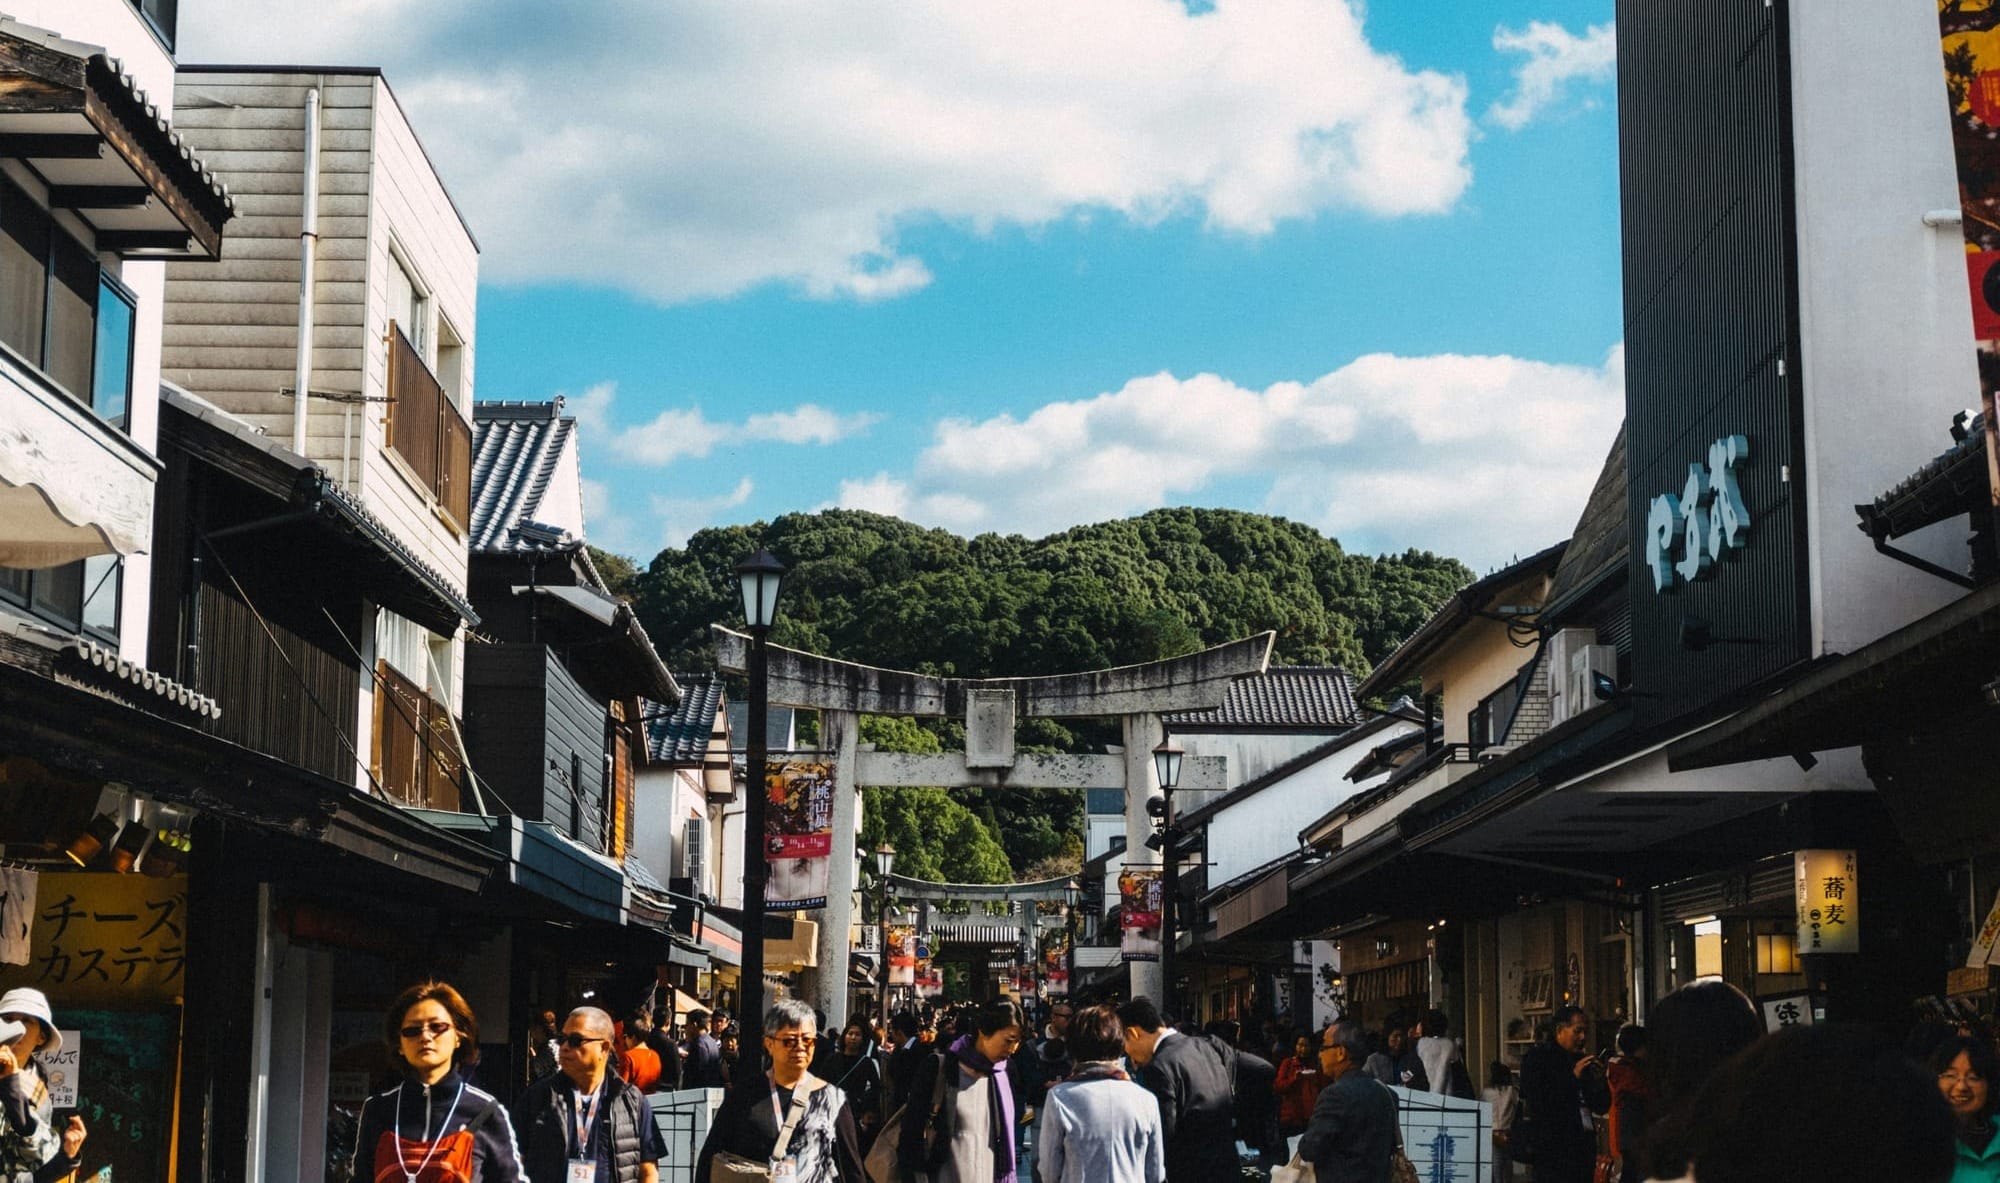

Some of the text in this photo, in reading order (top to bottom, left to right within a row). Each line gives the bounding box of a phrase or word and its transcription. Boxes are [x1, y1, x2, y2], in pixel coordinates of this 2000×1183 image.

[42, 894, 187, 943] チーズ
[1822, 876, 1846, 926] 蕎麦
[38, 946, 187, 985] カステラ
